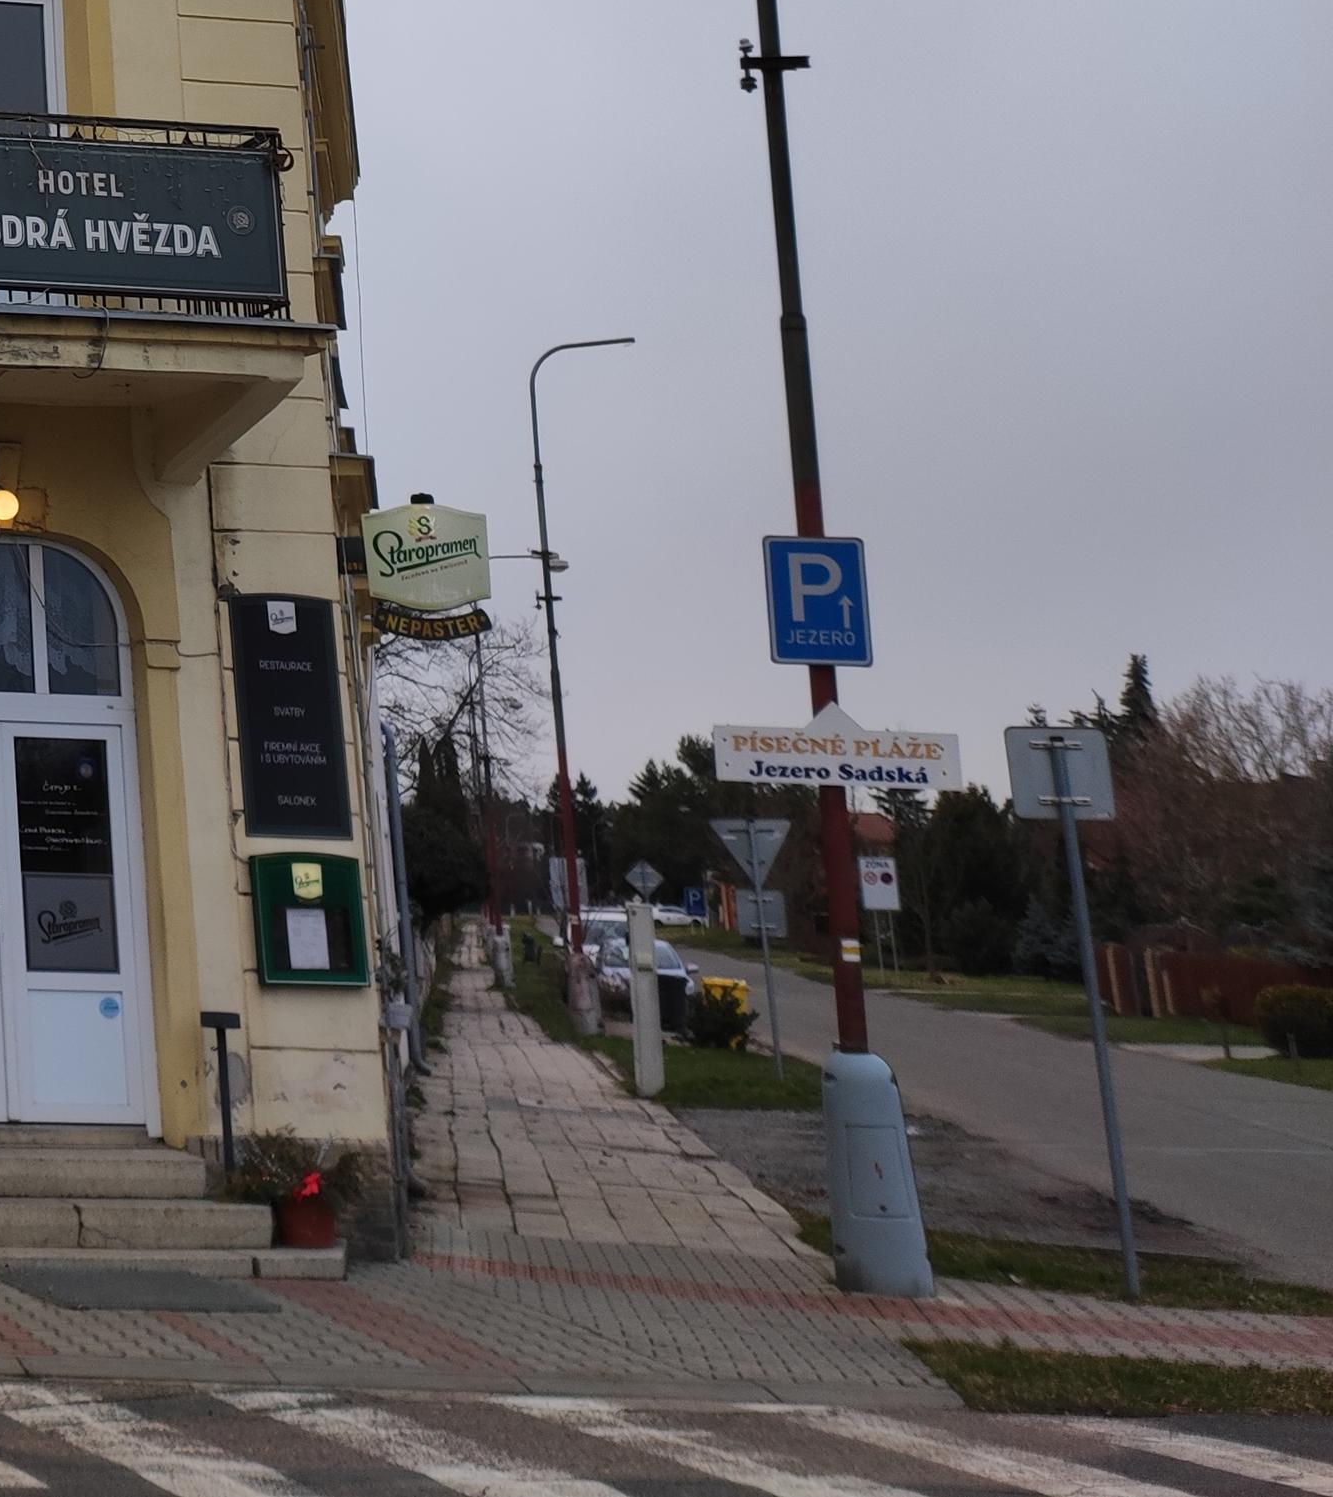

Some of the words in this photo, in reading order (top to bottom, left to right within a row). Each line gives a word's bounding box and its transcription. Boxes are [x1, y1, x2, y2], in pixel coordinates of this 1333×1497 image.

[38, 169, 124, 198] HOTEL
[84, 212, 222, 258] HVĚZDA
[373, 530, 481, 578] Staropramen
[788, 552, 842, 622] P
[385, 613, 480, 638] NEPASTER
[786, 629, 856, 646] JEZERO
[259, 660, 313, 672] RESTAURACE
[732, 731, 847, 756] PÍSEČNÉ
[853, 737, 945, 760] PLÁŽE
[749, 761, 830, 779] Jezero
[838, 764, 929, 784] Sadská
[689, 890, 701, 907] P
